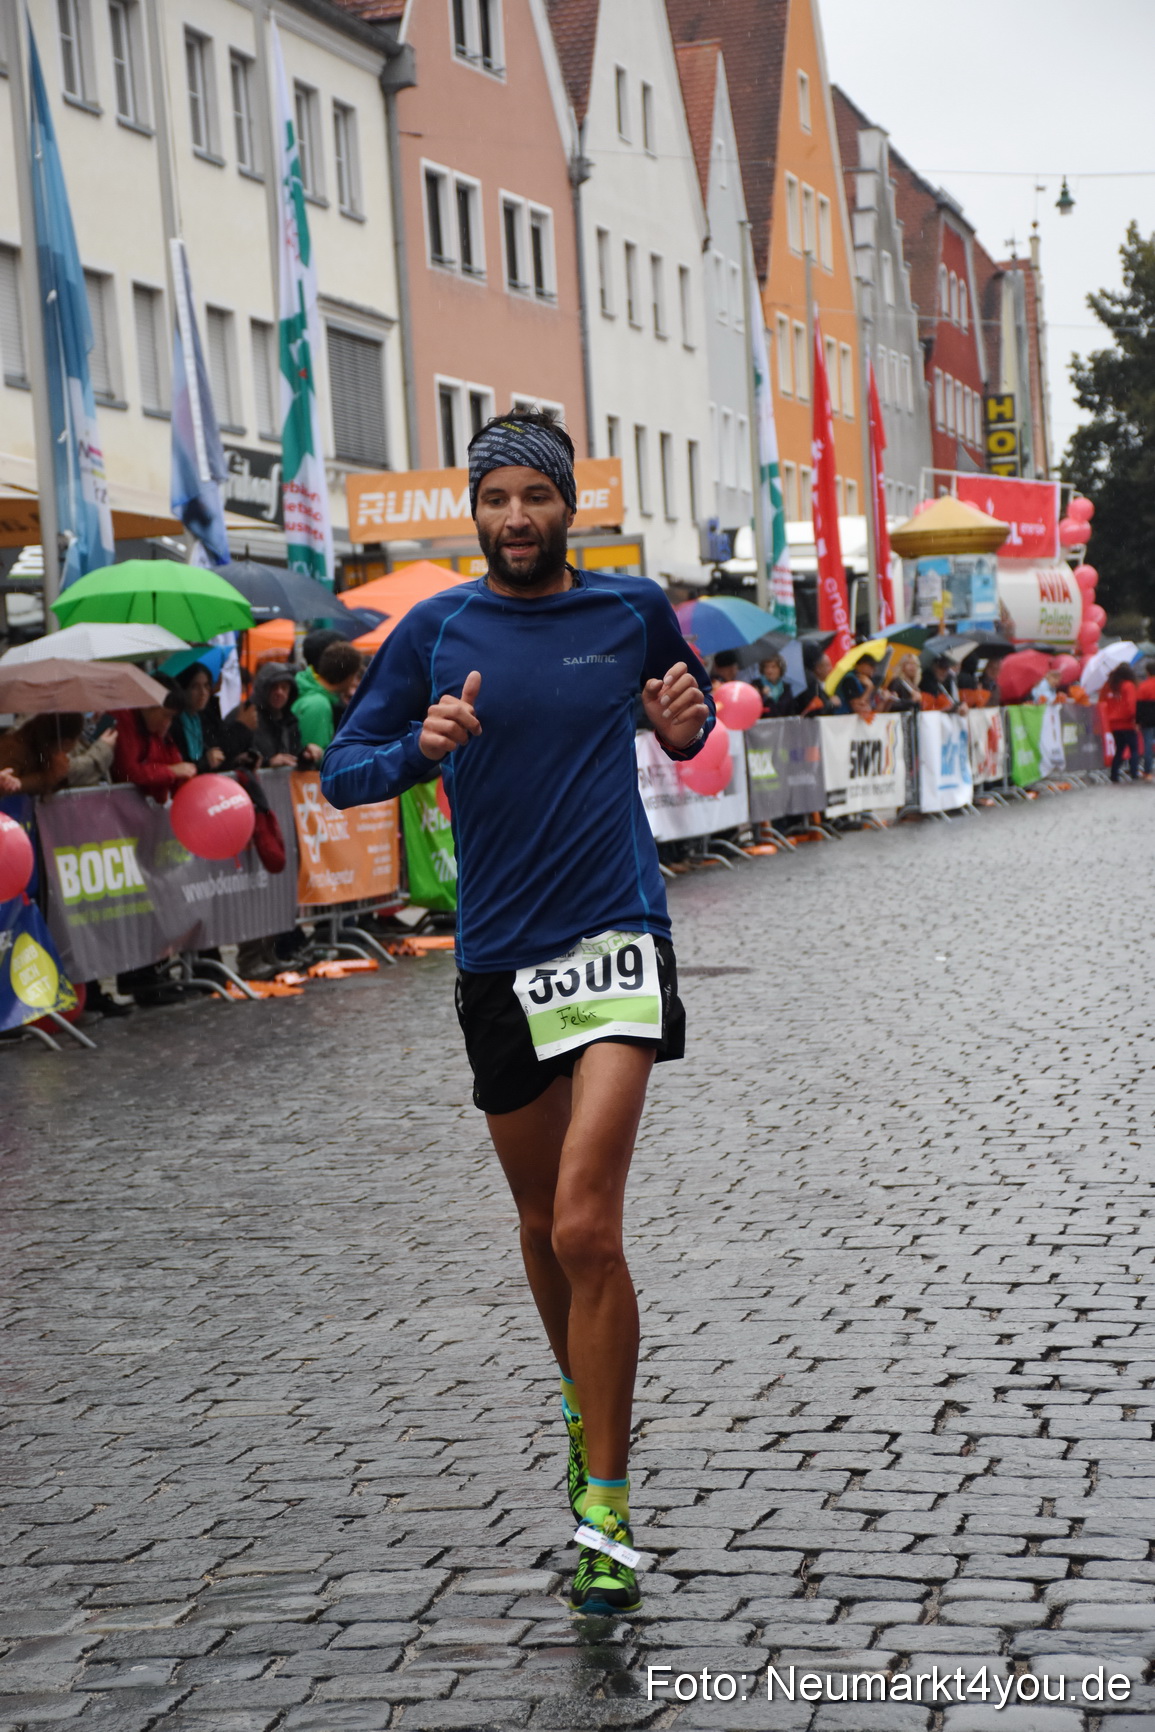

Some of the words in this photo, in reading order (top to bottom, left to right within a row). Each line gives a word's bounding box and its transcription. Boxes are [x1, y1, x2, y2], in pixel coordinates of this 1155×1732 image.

[1037, 570, 1073, 603] AVIA
[56, 845, 145, 898] BOCK
[528, 943, 644, 1005] 5309
[556, 1006, 597, 1030] Felix
